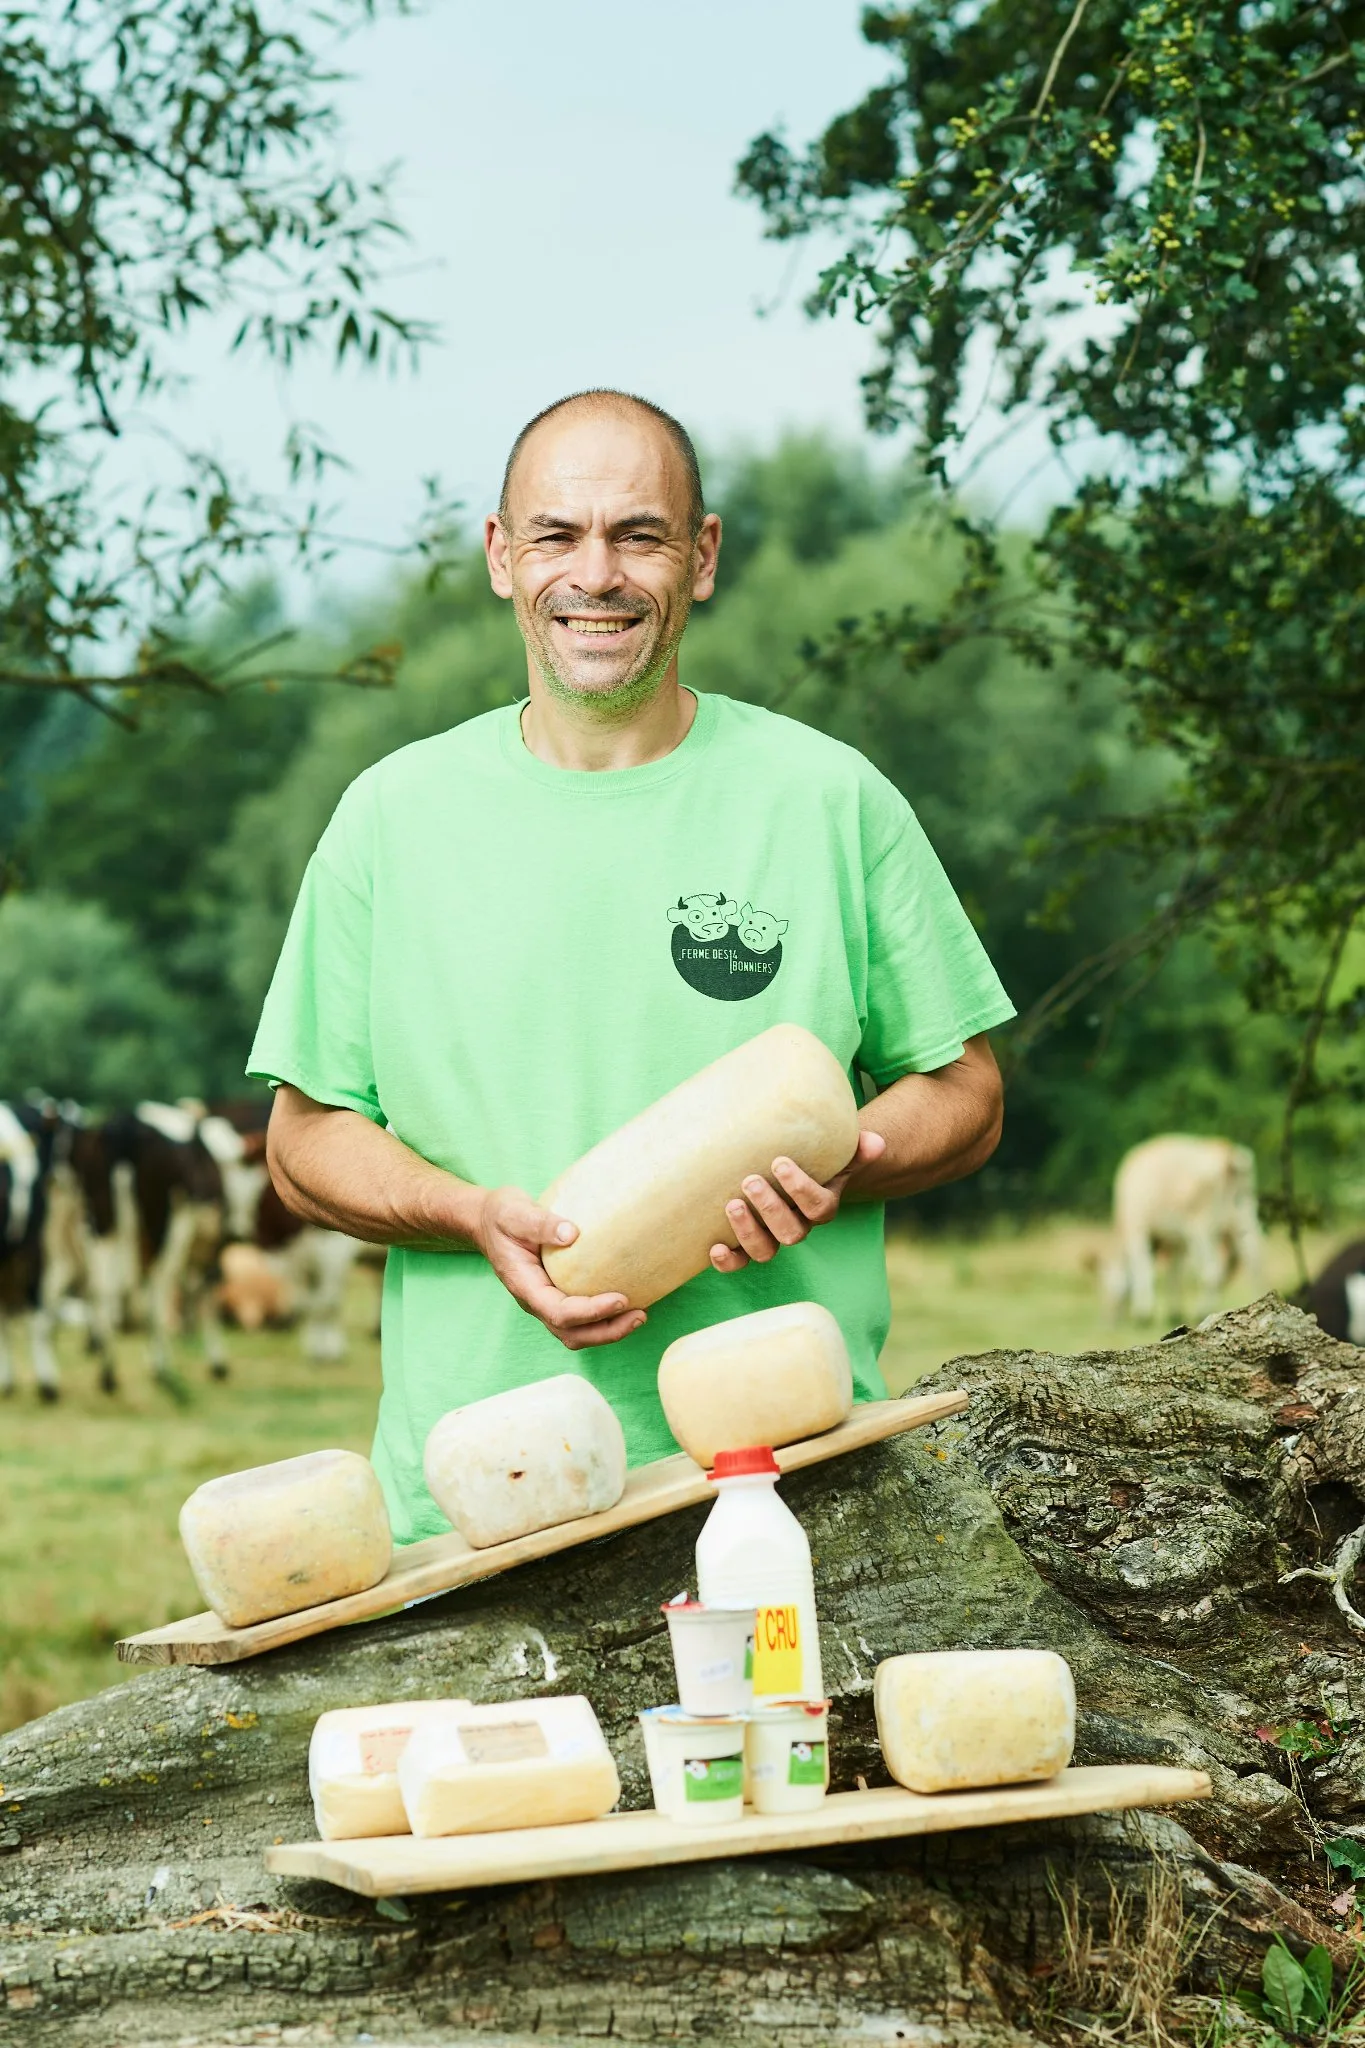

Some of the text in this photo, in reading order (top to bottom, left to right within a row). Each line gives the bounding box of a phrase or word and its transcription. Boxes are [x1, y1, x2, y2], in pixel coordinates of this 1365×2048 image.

[681, 948, 710, 960] FERME
[712, 949, 729, 960] DES
[732, 961, 772, 974] BONNIERS
[765, 1607, 797, 1651] CRU
